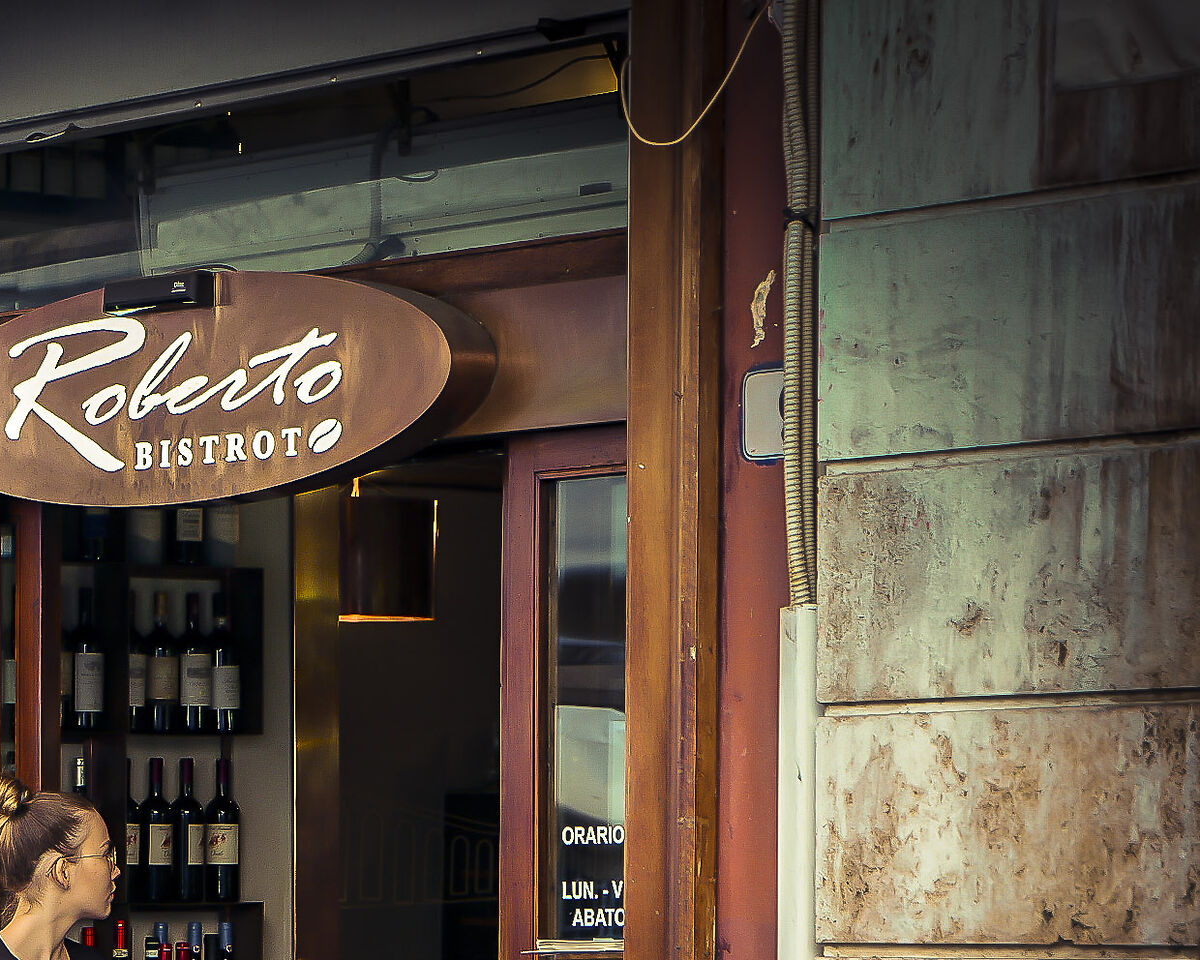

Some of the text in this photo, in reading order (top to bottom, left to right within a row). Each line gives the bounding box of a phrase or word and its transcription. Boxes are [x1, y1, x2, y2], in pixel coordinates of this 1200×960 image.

[4, 317, 345, 472] Roberto
[134, 427, 302, 471] BISTROT
[561, 825, 625, 846] ORARIO
[561, 880, 599, 900] LUN.
